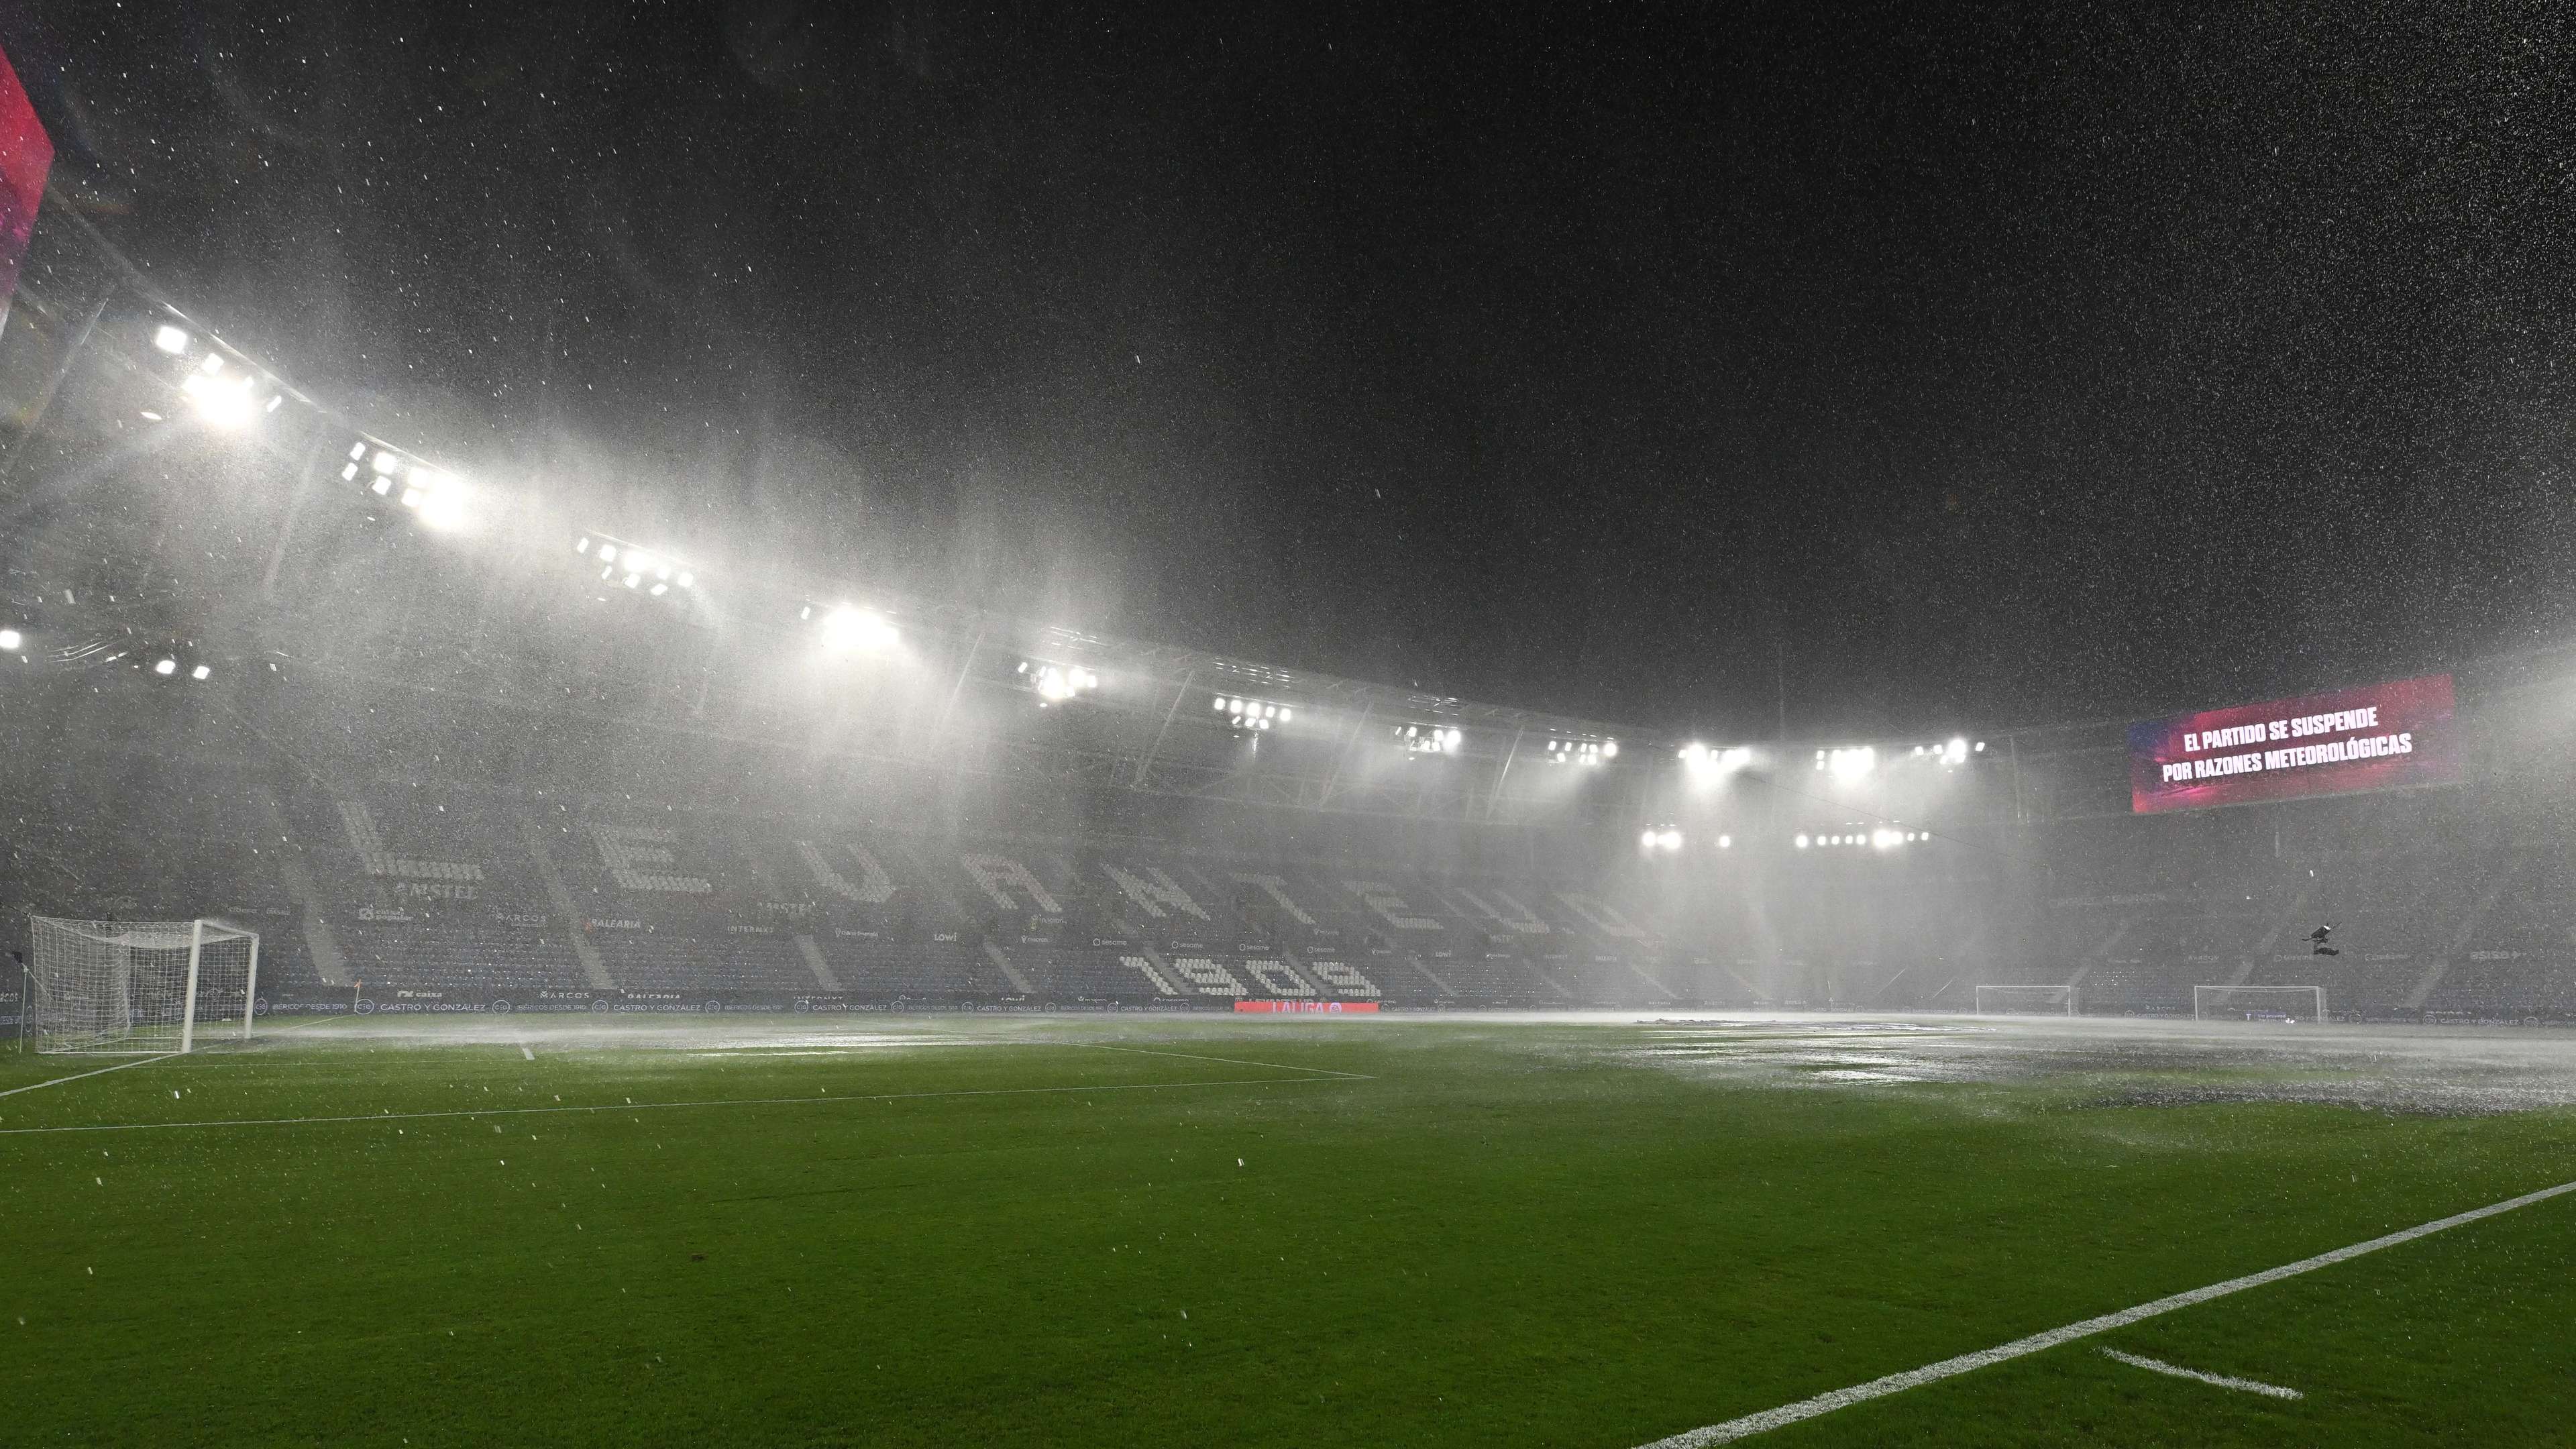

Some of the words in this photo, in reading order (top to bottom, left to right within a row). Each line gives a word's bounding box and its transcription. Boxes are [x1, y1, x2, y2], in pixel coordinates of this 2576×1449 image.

[2184, 733, 2200, 752] EL
[2202, 723, 2266, 750] PARTIDO
[2269, 720, 2289, 741] SE
[2290, 706, 2379, 738] SUSPENDE
[2163, 762, 2193, 782] POR
[2195, 753, 2263, 778] RAZONES
[2265, 733, 2412, 771] METEOROLÓGICAS
[1120, 956, 1382, 998] 1909
[1272, 1002, 1324, 1014] LALIGA
